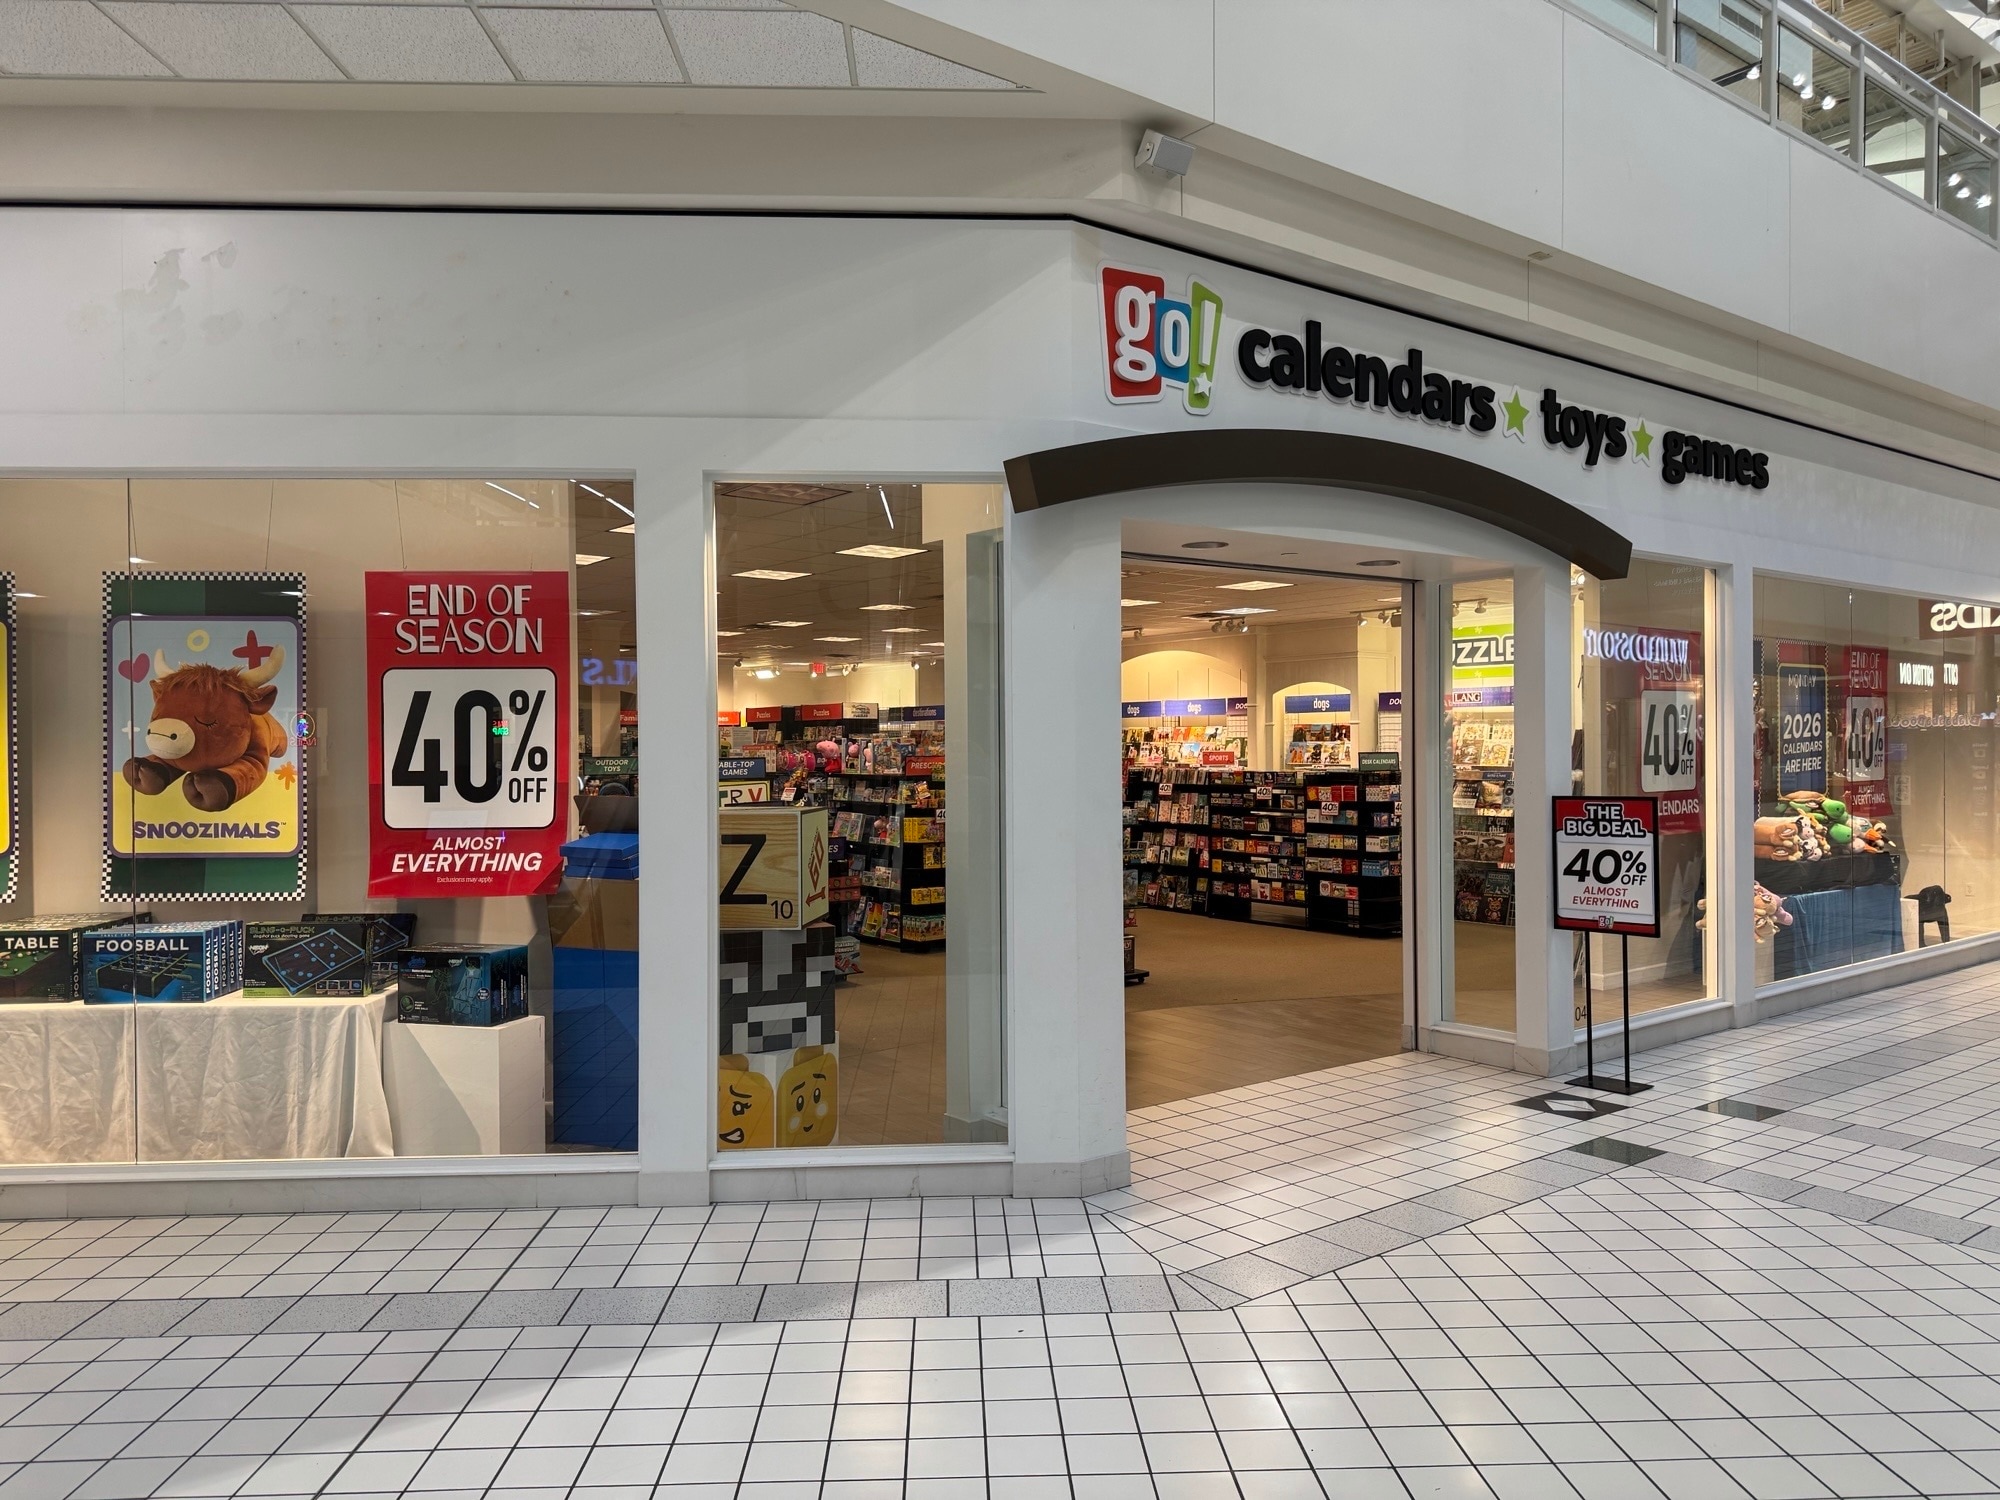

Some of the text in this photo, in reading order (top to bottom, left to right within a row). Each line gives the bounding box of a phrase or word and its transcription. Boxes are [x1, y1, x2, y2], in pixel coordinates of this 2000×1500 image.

[1112, 284, 1770, 489] go! calendars toys games
[408, 583, 533, 616] END OF
[395, 617, 543, 654] SEASON
[1644, 659, 1692, 682] SEASON
[1849, 670, 1883, 690] SEASON
[1313, 698, 1330, 711] dogs
[1454, 692, 1481, 702] LANG
[756, 711, 771, 719] Puzzles
[813, 708, 830, 717] Puzzles
[1127, 705, 1140, 716] dogs
[1187, 702, 1202, 714] dogs
[1783, 712, 1822, 740] 2026
[391, 688, 549, 804] 40%
[1643, 703, 1695, 776] 40%
[1848, 707, 1884, 769] 40%
[1783, 740, 1823, 755] CALENDARS
[718, 760, 755, 768] ABLE-TOP
[1680, 759, 1694, 776] OFF
[1784, 756, 1823, 774] ARE HERE
[1874, 753, 1884, 769] OFF
[722, 768, 749, 776] GAMES
[508, 777, 548, 804] OFF
[1586, 805, 1621, 820] THE
[1566, 820, 1644, 837] BIG DEAL
[432, 836, 507, 851] ALMOST
[391, 852, 543, 873] EVERYTHING
[719, 834, 768, 905] Z
[1562, 848, 1647, 885] 40%
[1620, 874, 1648, 886] OFF
[1582, 885, 1629, 897] ALMOST
[770, 900, 793, 920] 10
[1572, 896, 1640, 909] EVERYTHING
[4, 937, 59, 950] TABLE
[95, 938, 190, 952] FOOSBALL
